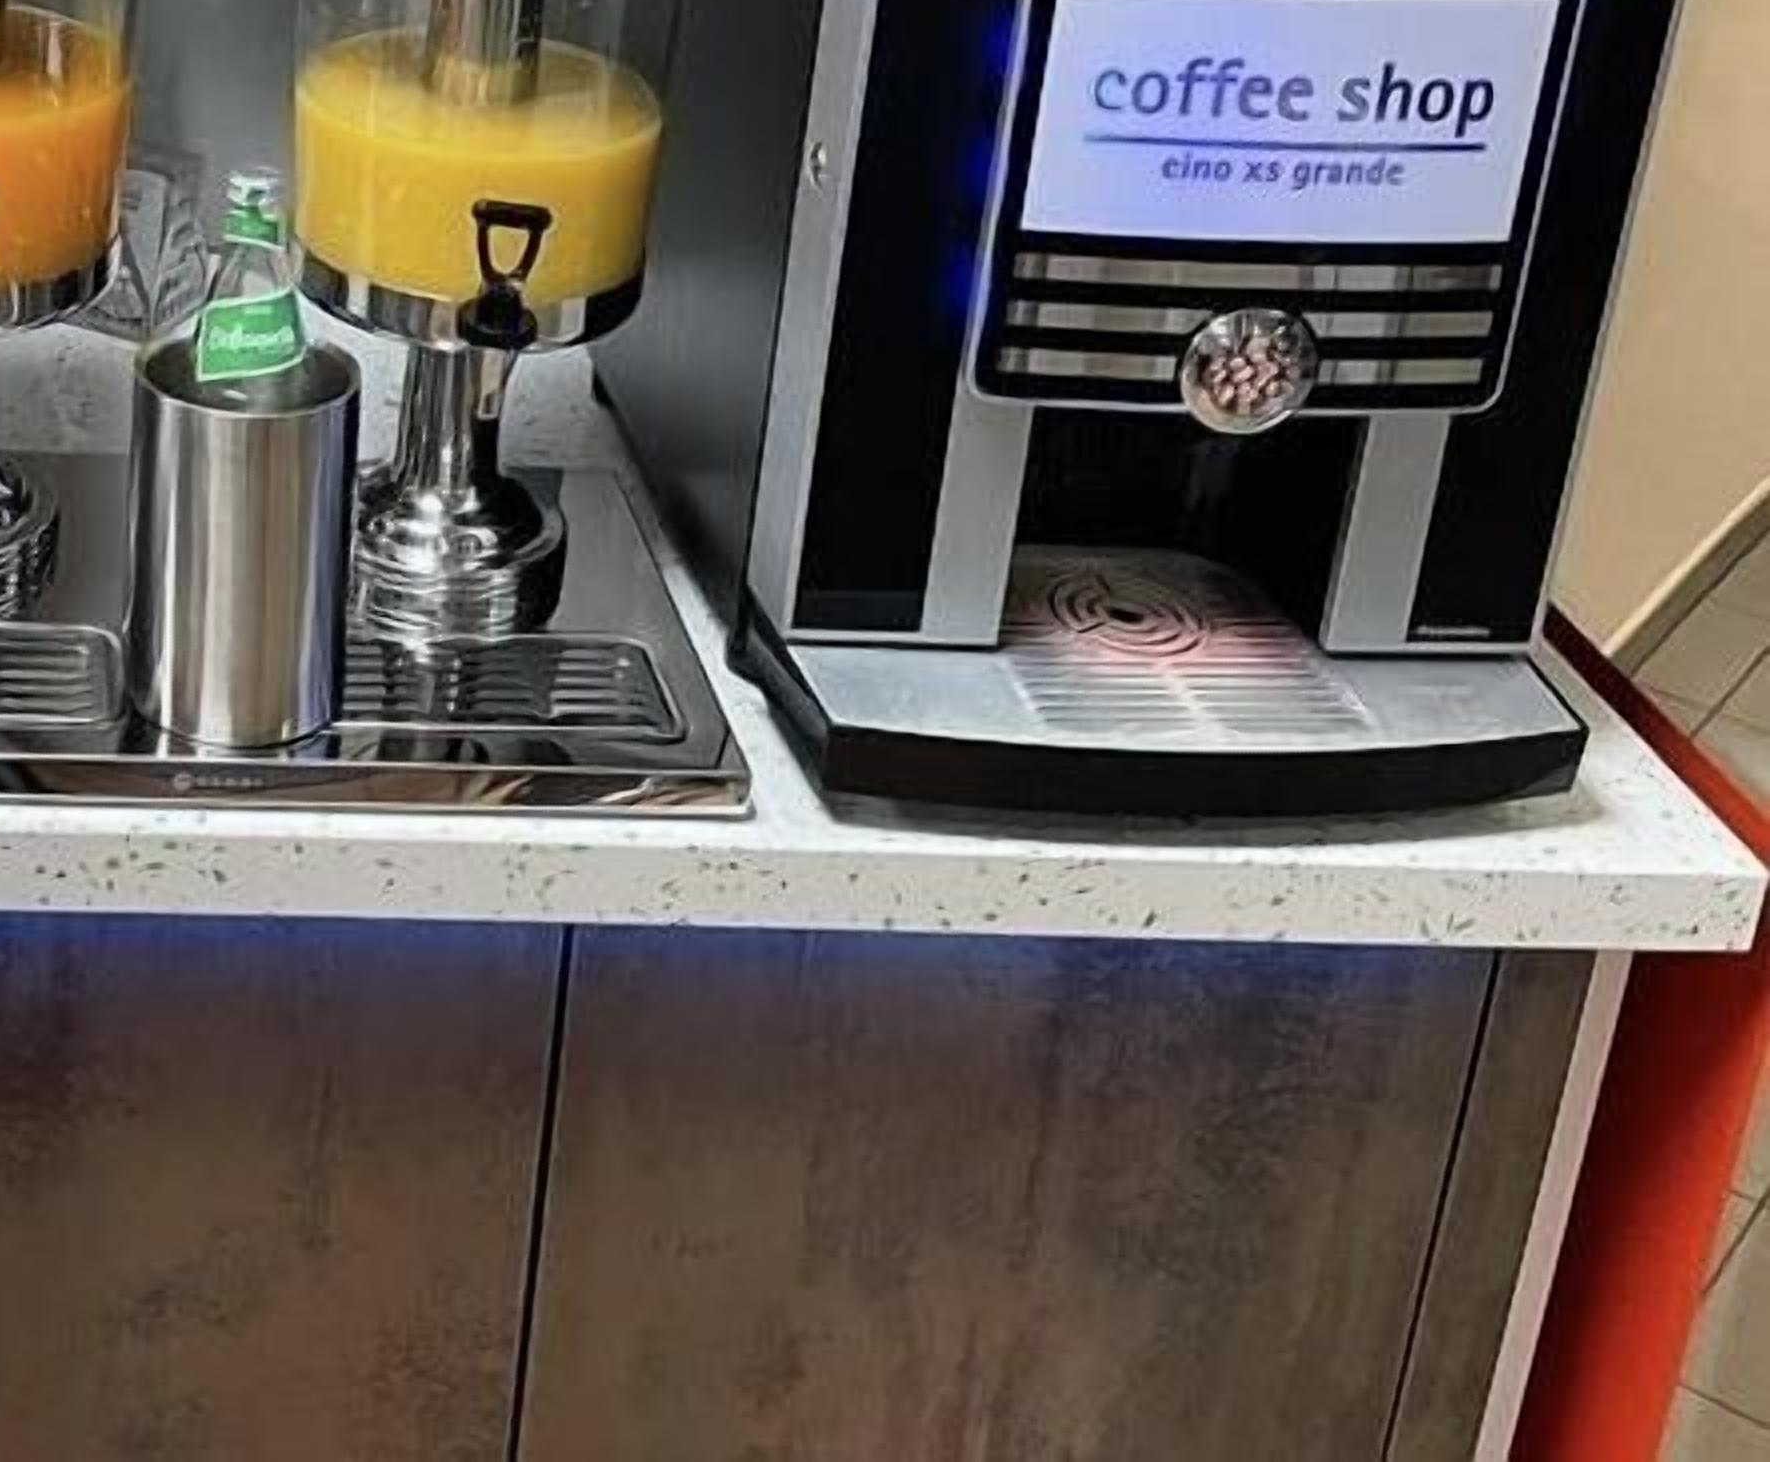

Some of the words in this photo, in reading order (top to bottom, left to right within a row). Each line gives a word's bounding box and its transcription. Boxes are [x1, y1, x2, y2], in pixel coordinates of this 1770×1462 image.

[1093, 56, 1315, 122] coffee
[1336, 62, 1496, 138] shop
[1161, 151, 1232, 181] cino
[1243, 157, 1281, 182] xs
[1292, 154, 1407, 191] grande
